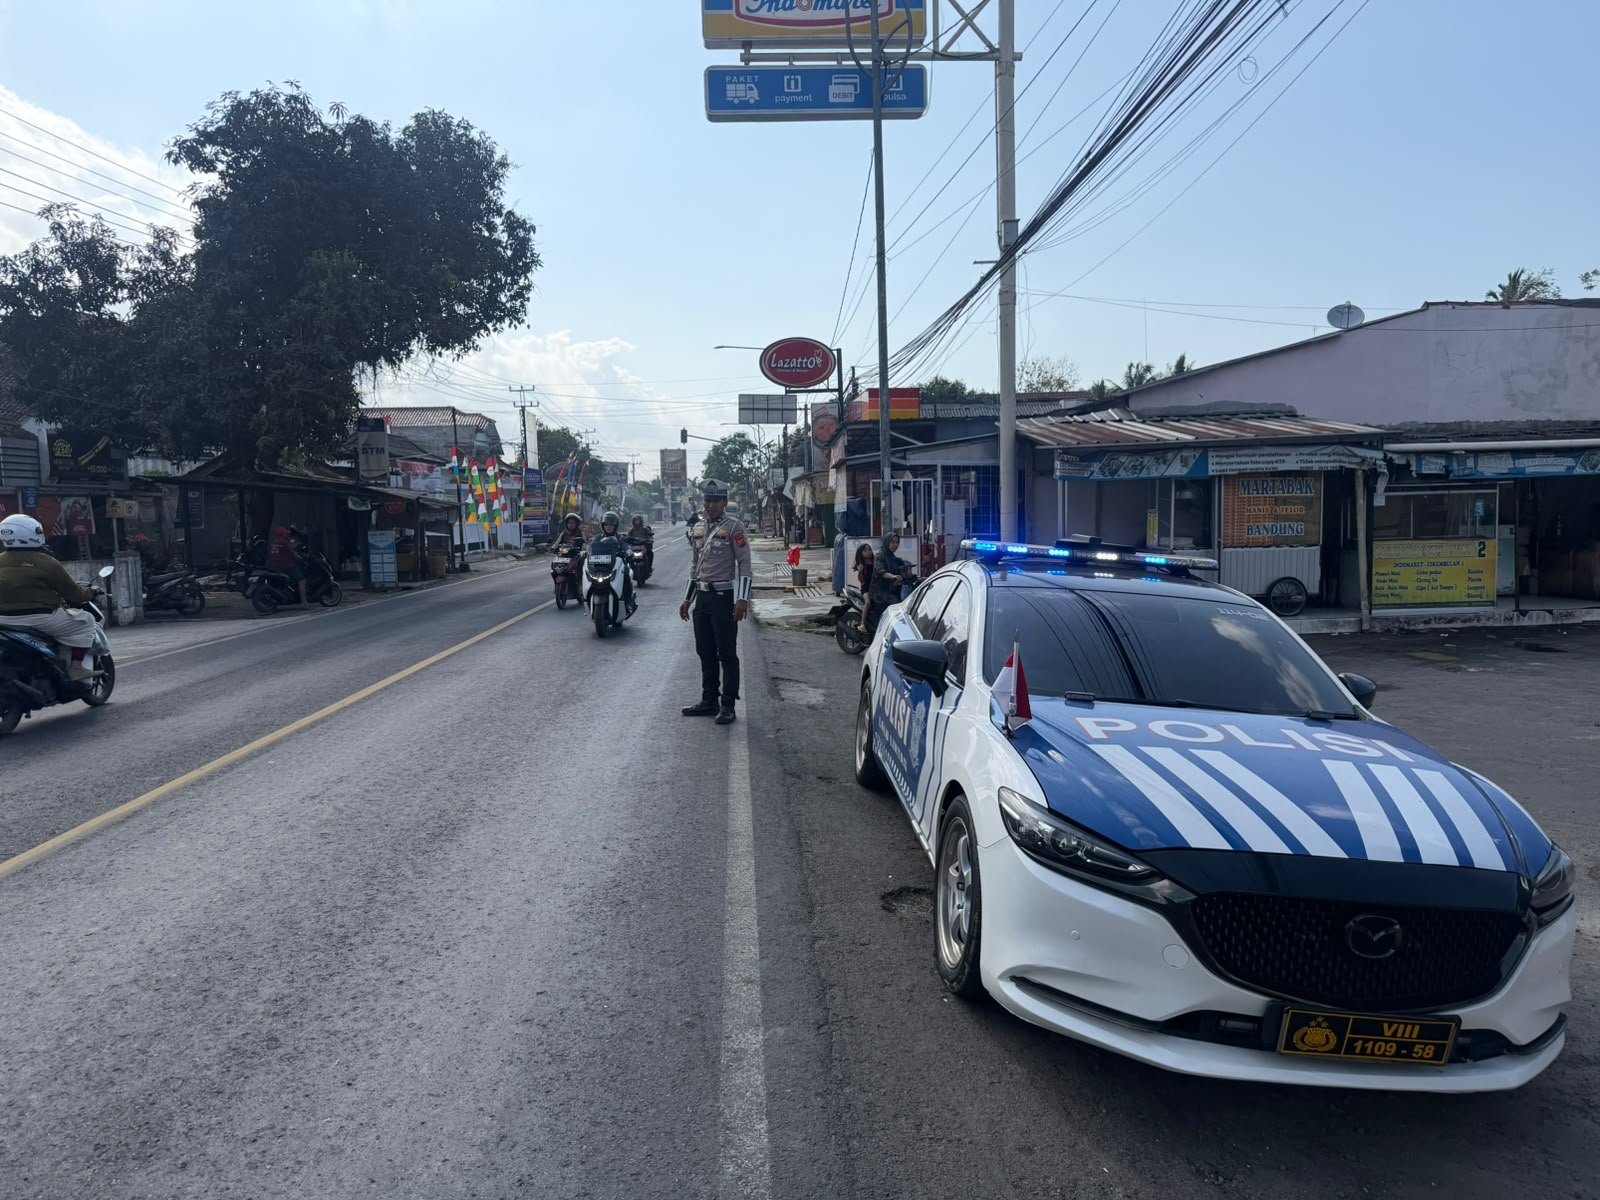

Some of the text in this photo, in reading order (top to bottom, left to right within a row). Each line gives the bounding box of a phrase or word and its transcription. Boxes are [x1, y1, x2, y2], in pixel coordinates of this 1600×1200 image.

[725, 75, 760, 83] PAKET
[775, 94, 813, 104] payment
[883, 93, 907, 103] pulsa
[771, 352, 816, 369] Lazatto
[362, 447, 385, 455] ATM
[1240, 478, 1314, 496] MARTABAK
[1246, 506, 1272, 514] MANIS
[1247, 522, 1304, 536] BANDUNG
[1478, 541, 1487, 557] 2
[879, 672, 911, 746] POLISI
[1074, 717, 1414, 762] POLISI
[1382, 1023, 1421, 1039] VIII
[1353, 1040, 1396, 1055] 1109
[1412, 1044, 1435, 1059] 58
